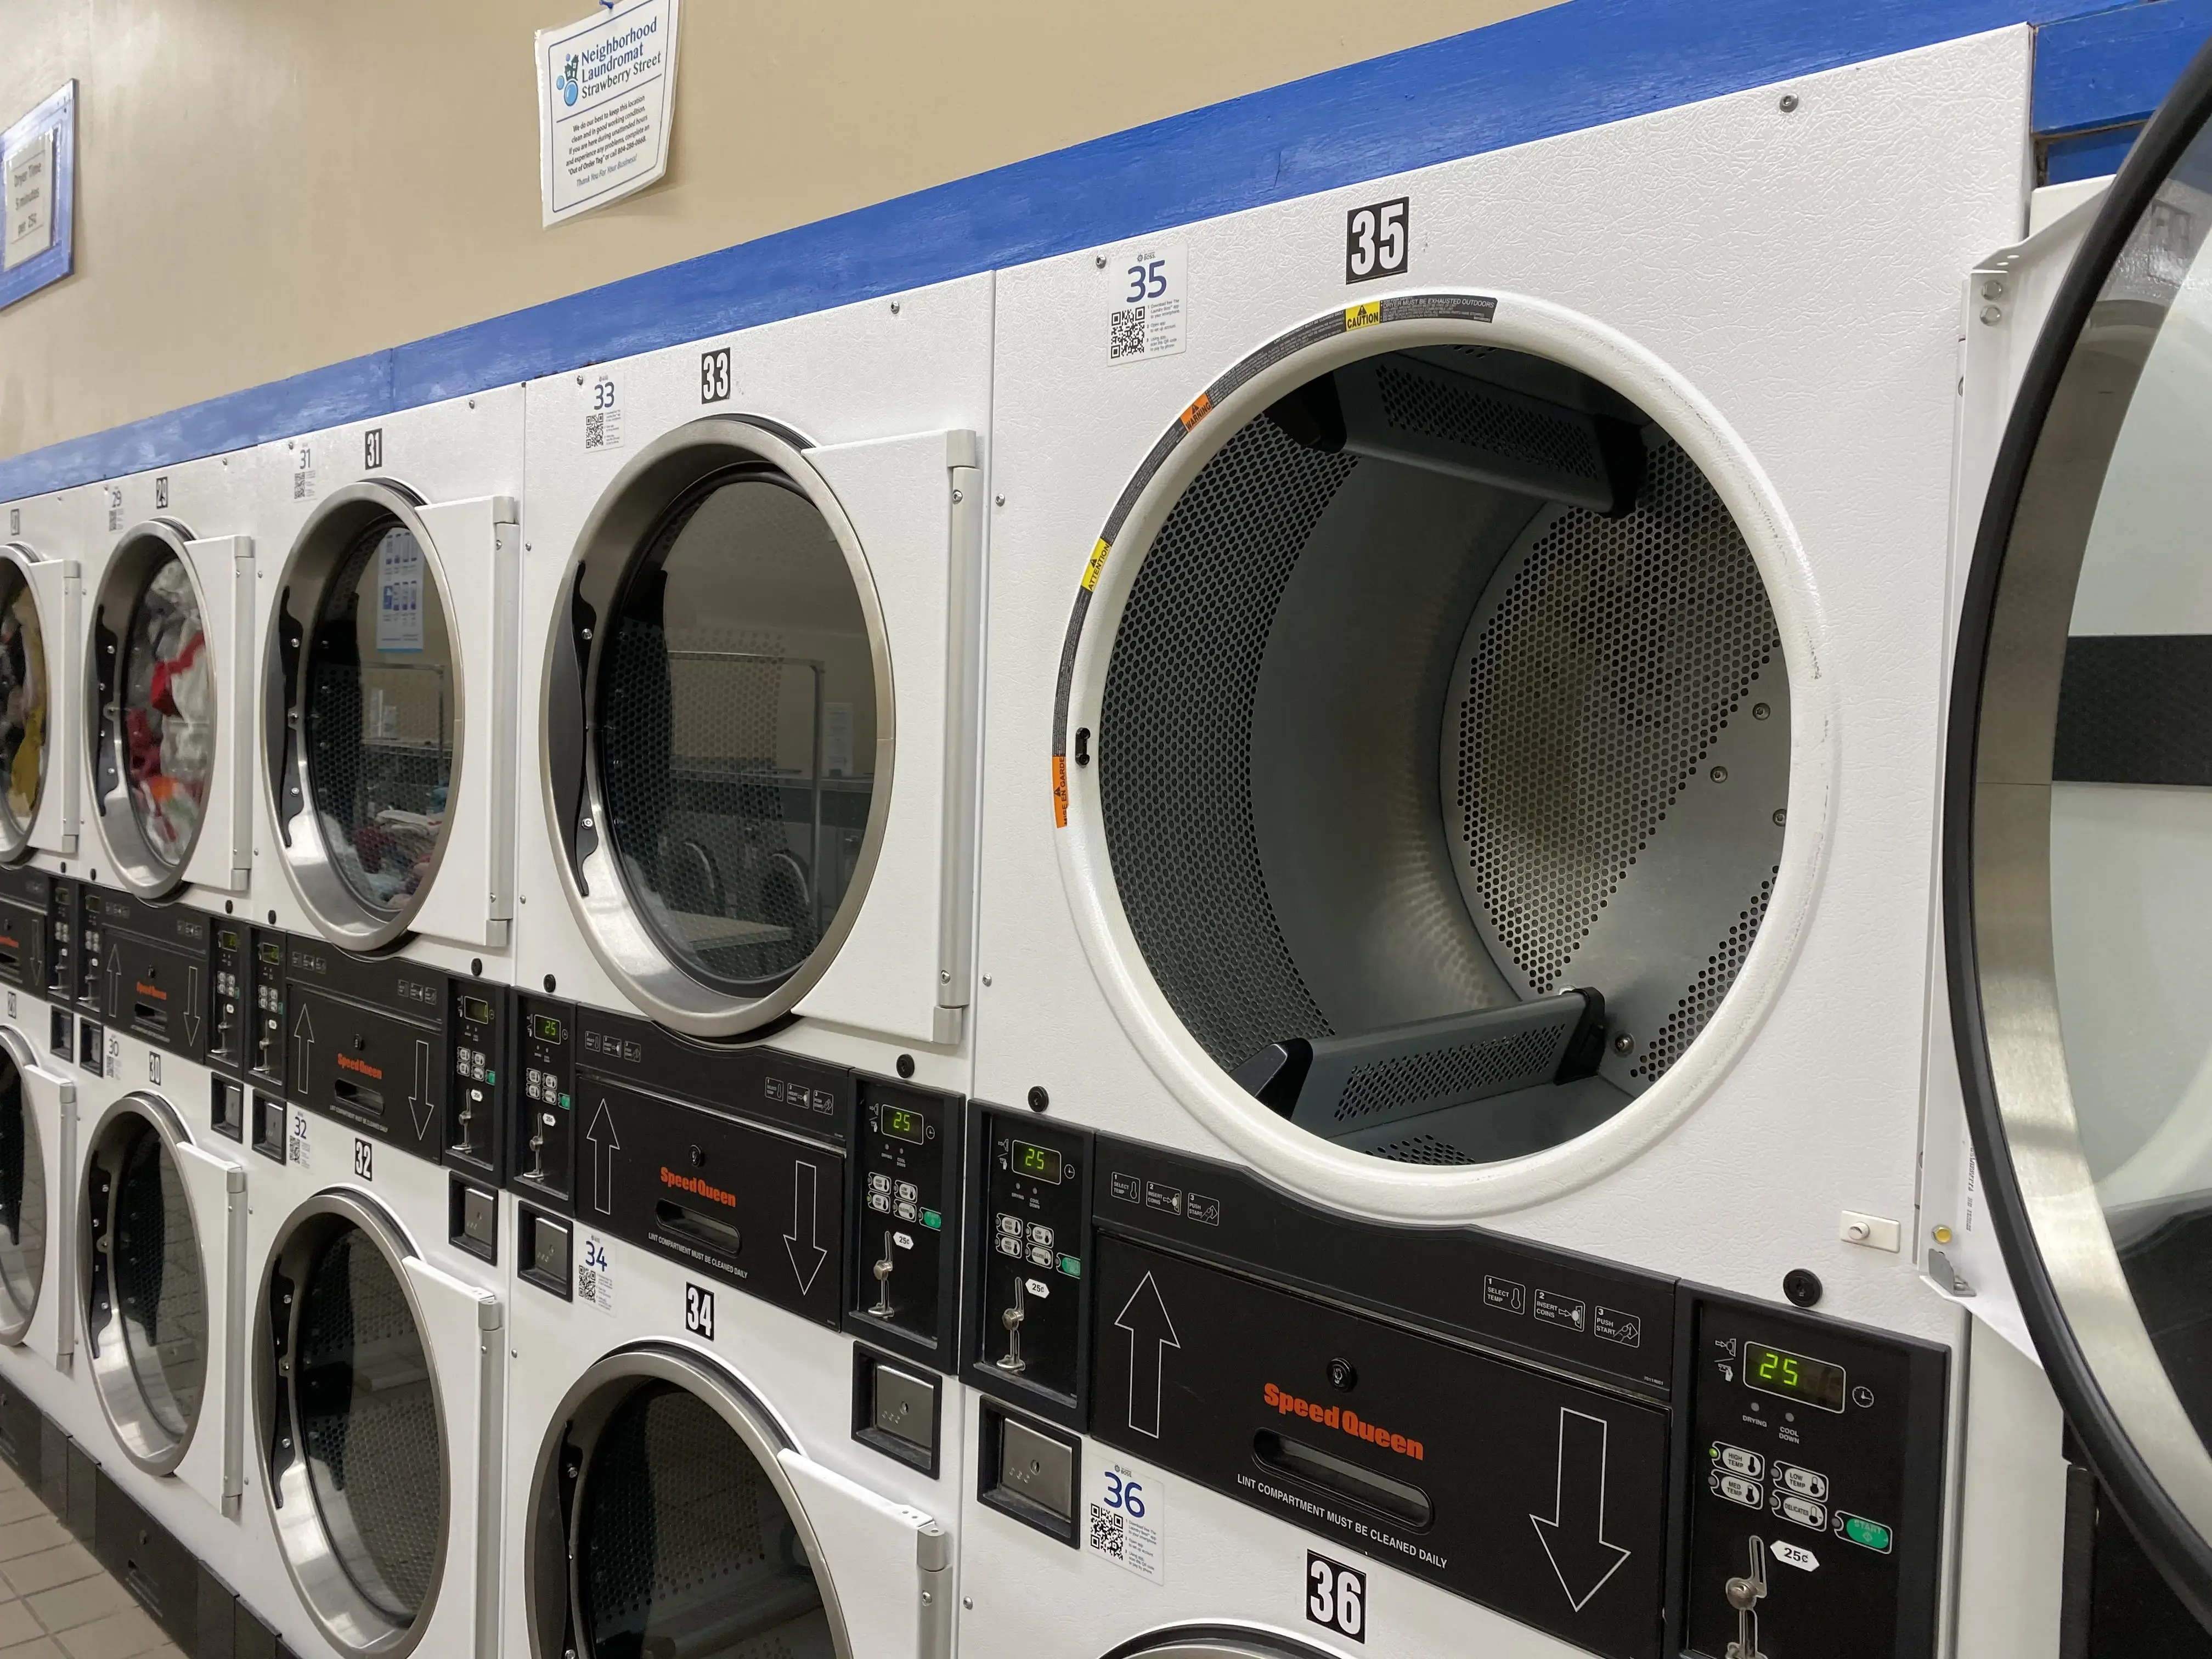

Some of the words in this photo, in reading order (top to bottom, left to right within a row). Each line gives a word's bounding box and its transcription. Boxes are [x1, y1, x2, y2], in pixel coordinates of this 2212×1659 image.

[582, 16, 657, 66] Neighborhood
[582, 42, 643, 83] Laundromat
[582, 68, 630, 98] Strawberry
[633, 51, 661, 75] Street
[595, 115, 603, 123] best
[609, 108, 619, 117] keep
[628, 95, 645, 108] location
[572, 134, 583, 143] clean
[596, 122, 607, 134] good
[608, 115, 624, 128] working
[588, 139, 597, 147] here
[598, 133, 611, 143] during
[612, 121, 635, 137] unattended
[636, 115, 647, 125] hours
[574, 150, 596, 163] experience
[625, 128, 644, 142] complete
[583, 160, 595, 170] Order
[577, 176, 590, 187] Thank
[607, 165, 617, 173] Your
[1351, 202, 1404, 275] 35
[1126, 259, 1166, 302] 35
[1462, 299, 1494, 308] OUTDOORS
[1347, 312, 1379, 329] CAUTION
[702, 352, 729, 400] 33
[594, 381, 615, 410] 33
[1186, 402, 1210, 430] WARNING
[300, 448, 311, 470] 31
[367, 432, 379, 467] 31
[112, 490, 122, 507] 29
[1088, 544, 1109, 590] ATTENTION
[1061, 790, 1066, 802] EN
[545, 1020, 556, 1036] 25
[109, 1039, 119, 1057] 30
[150, 1054, 160, 1083] 30
[338, 1053, 359, 1071] Speed
[295, 1116, 307, 1139] 32
[893, 1111, 910, 1131] 25
[356, 1141, 370, 1178] 32
[1025, 1148, 1045, 1170] 25
[661, 1166, 697, 1193] Speed
[698, 1180, 736, 1207] Queen
[1114, 1182, 1129, 1190] SELECT
[1148, 1191, 1163, 1199] INSERT
[899, 1236, 910, 1244] 25¢
[585, 1240, 607, 1272] 34
[648, 1232, 658, 1242] LINT
[658, 1237, 691, 1255] COMPARTMENT
[691, 1249, 704, 1261] MUST
[705, 1255, 711, 1264] BE
[712, 1258, 733, 1273] CLEANED
[734, 1267, 748, 1279] DAILY
[1032, 1283, 1044, 1293] 25¢
[1487, 1287, 1509, 1297] SELECT
[1487, 1294, 1503, 1302] TEMP
[1537, 1301, 1558, 1311] INSERT
[687, 1288, 712, 1336] 34
[1537, 1308, 1555, 1318] COINS
[1596, 1318, 1613, 1328] PUSH
[1596, 1325, 1616, 1335] START
[1759, 1353, 1798, 1385] 25
[1263, 1383, 1340, 1430] Speed
[1342, 1410, 1424, 1460] Queen
[1742, 1415, 1767, 1427] DRYING
[1779, 1433, 1799, 1444] DOWN
[1780, 1426, 1799, 1437] COOL
[1728, 1452, 1742, 1462] HIGH
[1728, 1459, 1743, 1468] TEMP
[1729, 1481, 1741, 1490] MED
[1790, 1472, 1803, 1481] LOW
[1790, 1479, 1805, 1488] TEMP
[1104, 1471, 1145, 1518] 36
[1727, 1488, 1742, 1497] TEMP
[1785, 1503, 1809, 1516] DELICATES
[1238, 1474, 1256, 1489] LINT
[1257, 1482, 1325, 1517] COMPARTMENT
[1327, 1511, 1353, 1529] MUST
[1356, 1523, 1368, 1537] BE
[1371, 1529, 1416, 1556] CLEANED
[1419, 1549, 1447, 1569] DAILY
[1854, 1520, 1882, 1534] START
[1784, 1547, 1809, 1563] 25¢
[1311, 1560, 1361, 1635] 36
